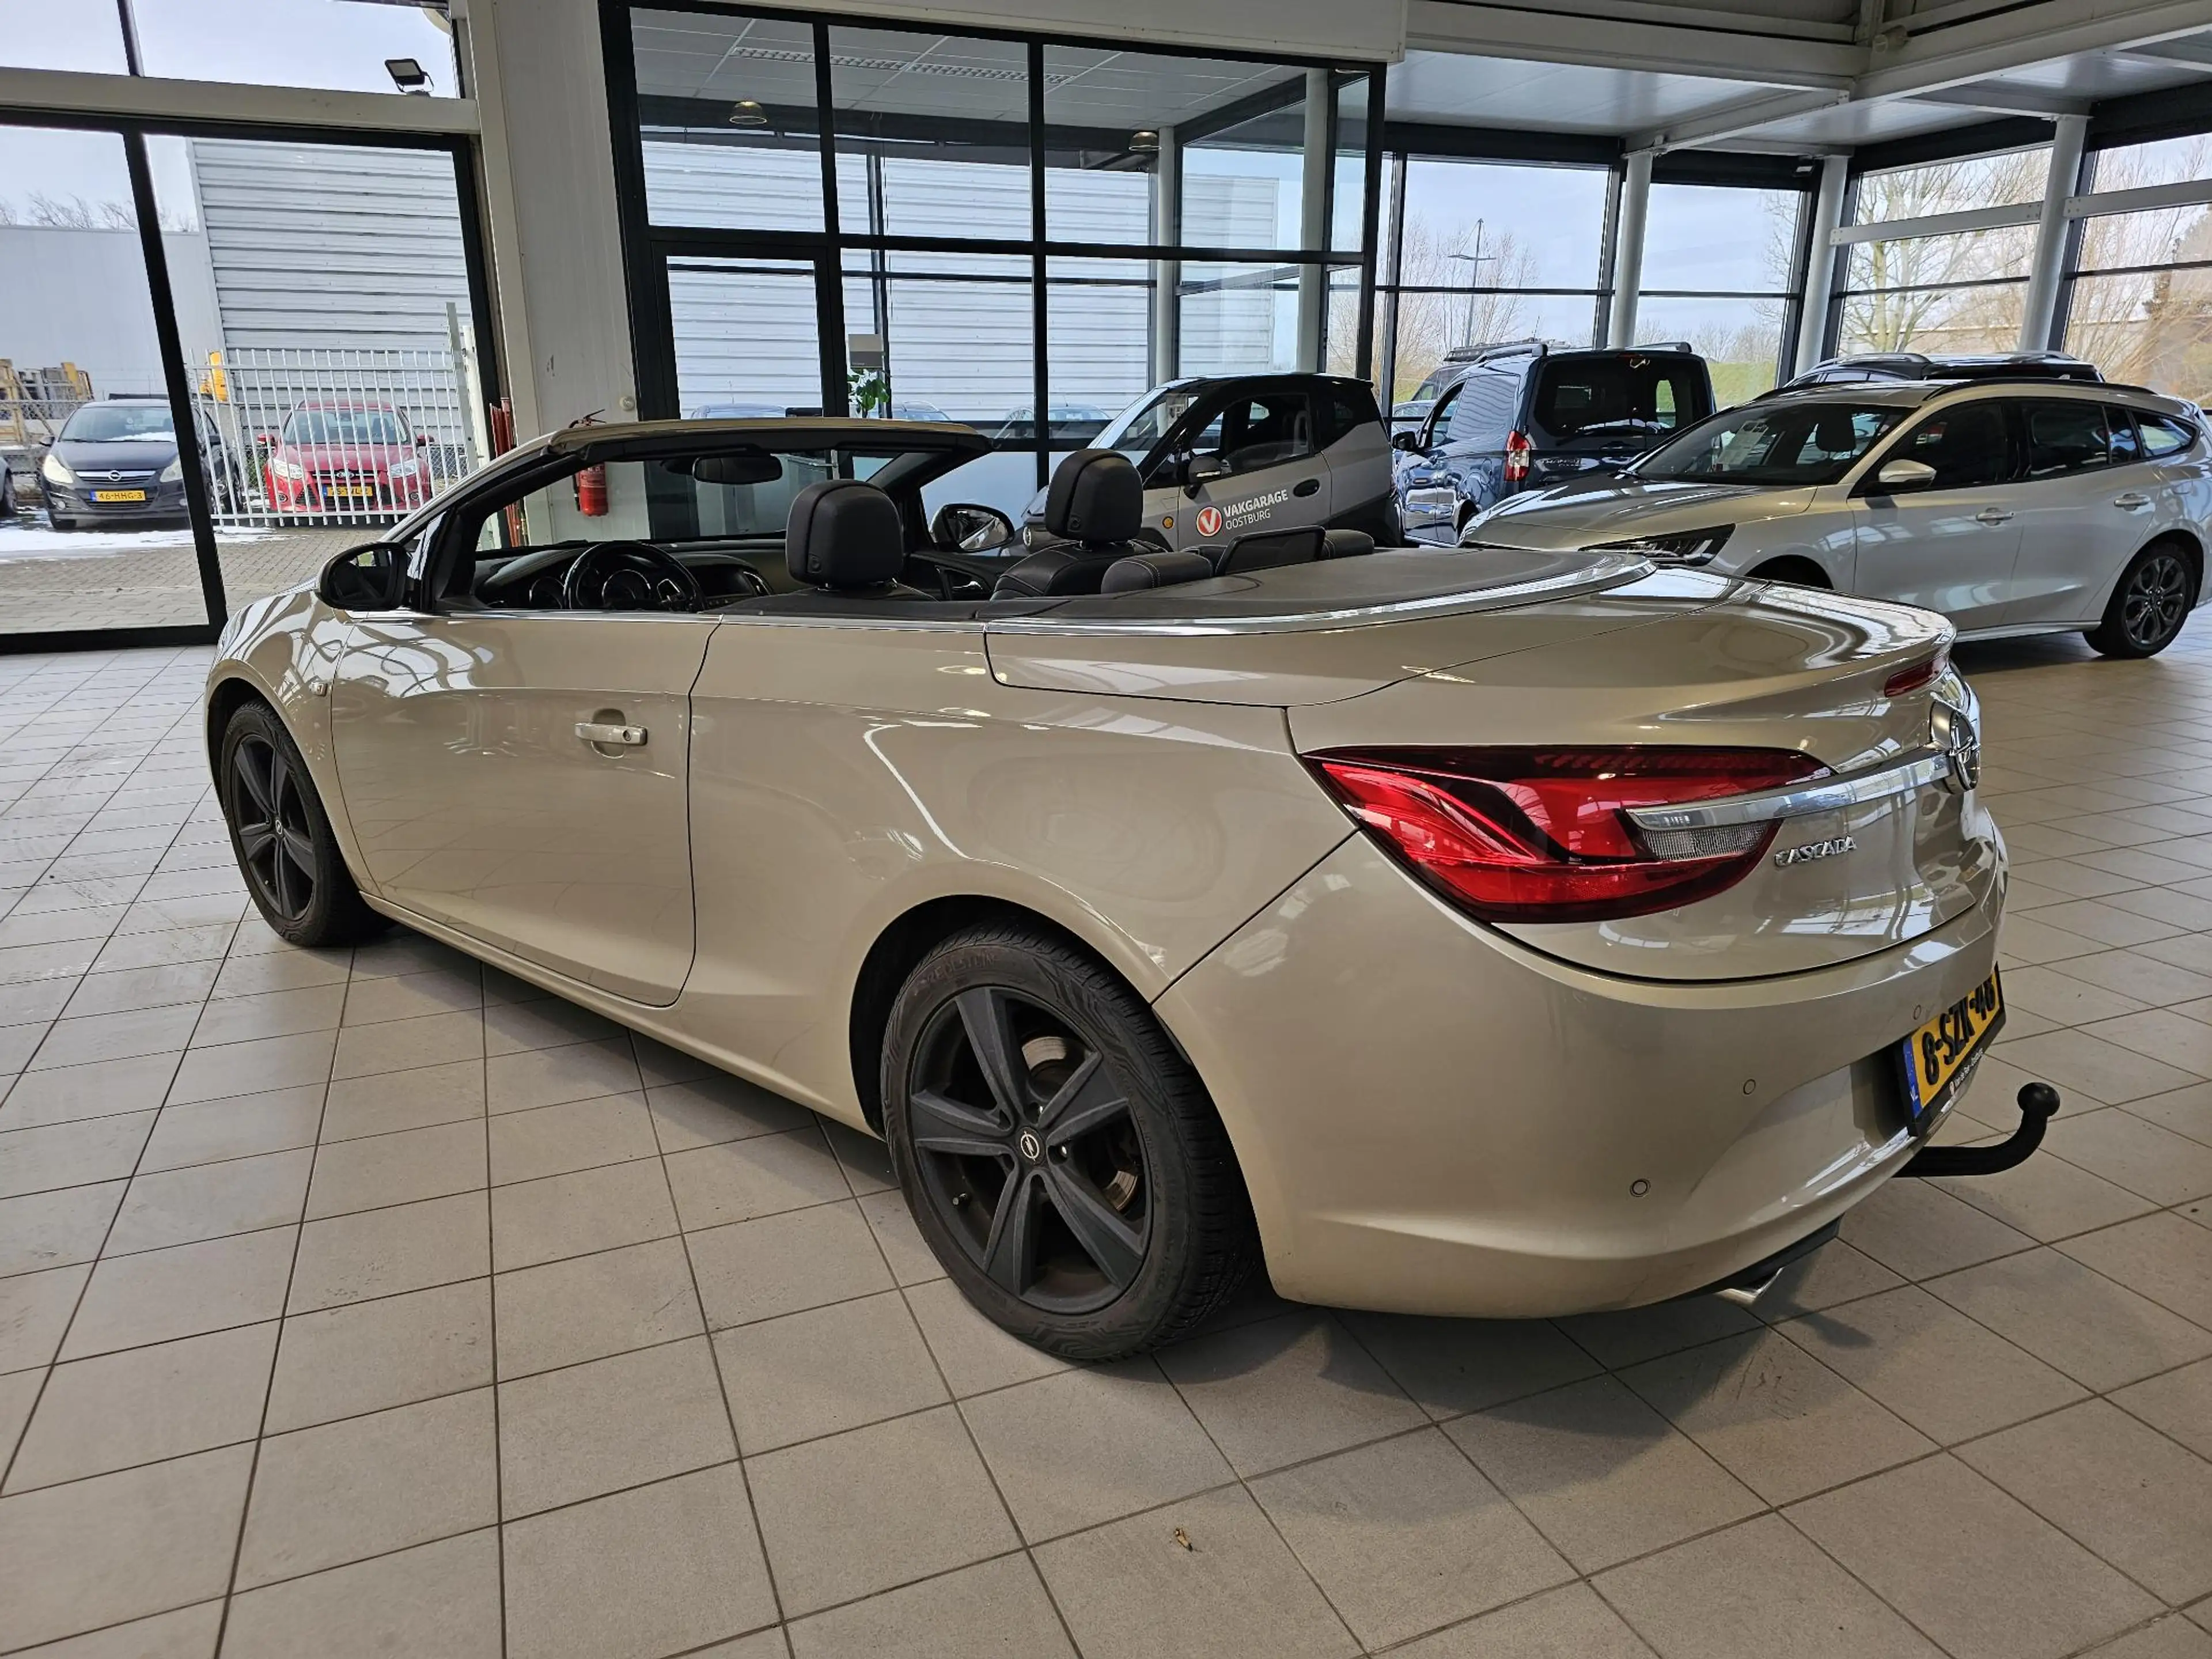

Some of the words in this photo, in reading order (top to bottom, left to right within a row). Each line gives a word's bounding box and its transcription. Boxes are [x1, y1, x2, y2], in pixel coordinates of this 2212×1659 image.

[1224, 489, 1288, 517] VAKGARAGE
[1226, 509, 1271, 530] OOSTBURG
[1774, 836, 1857, 867] CASCADA
